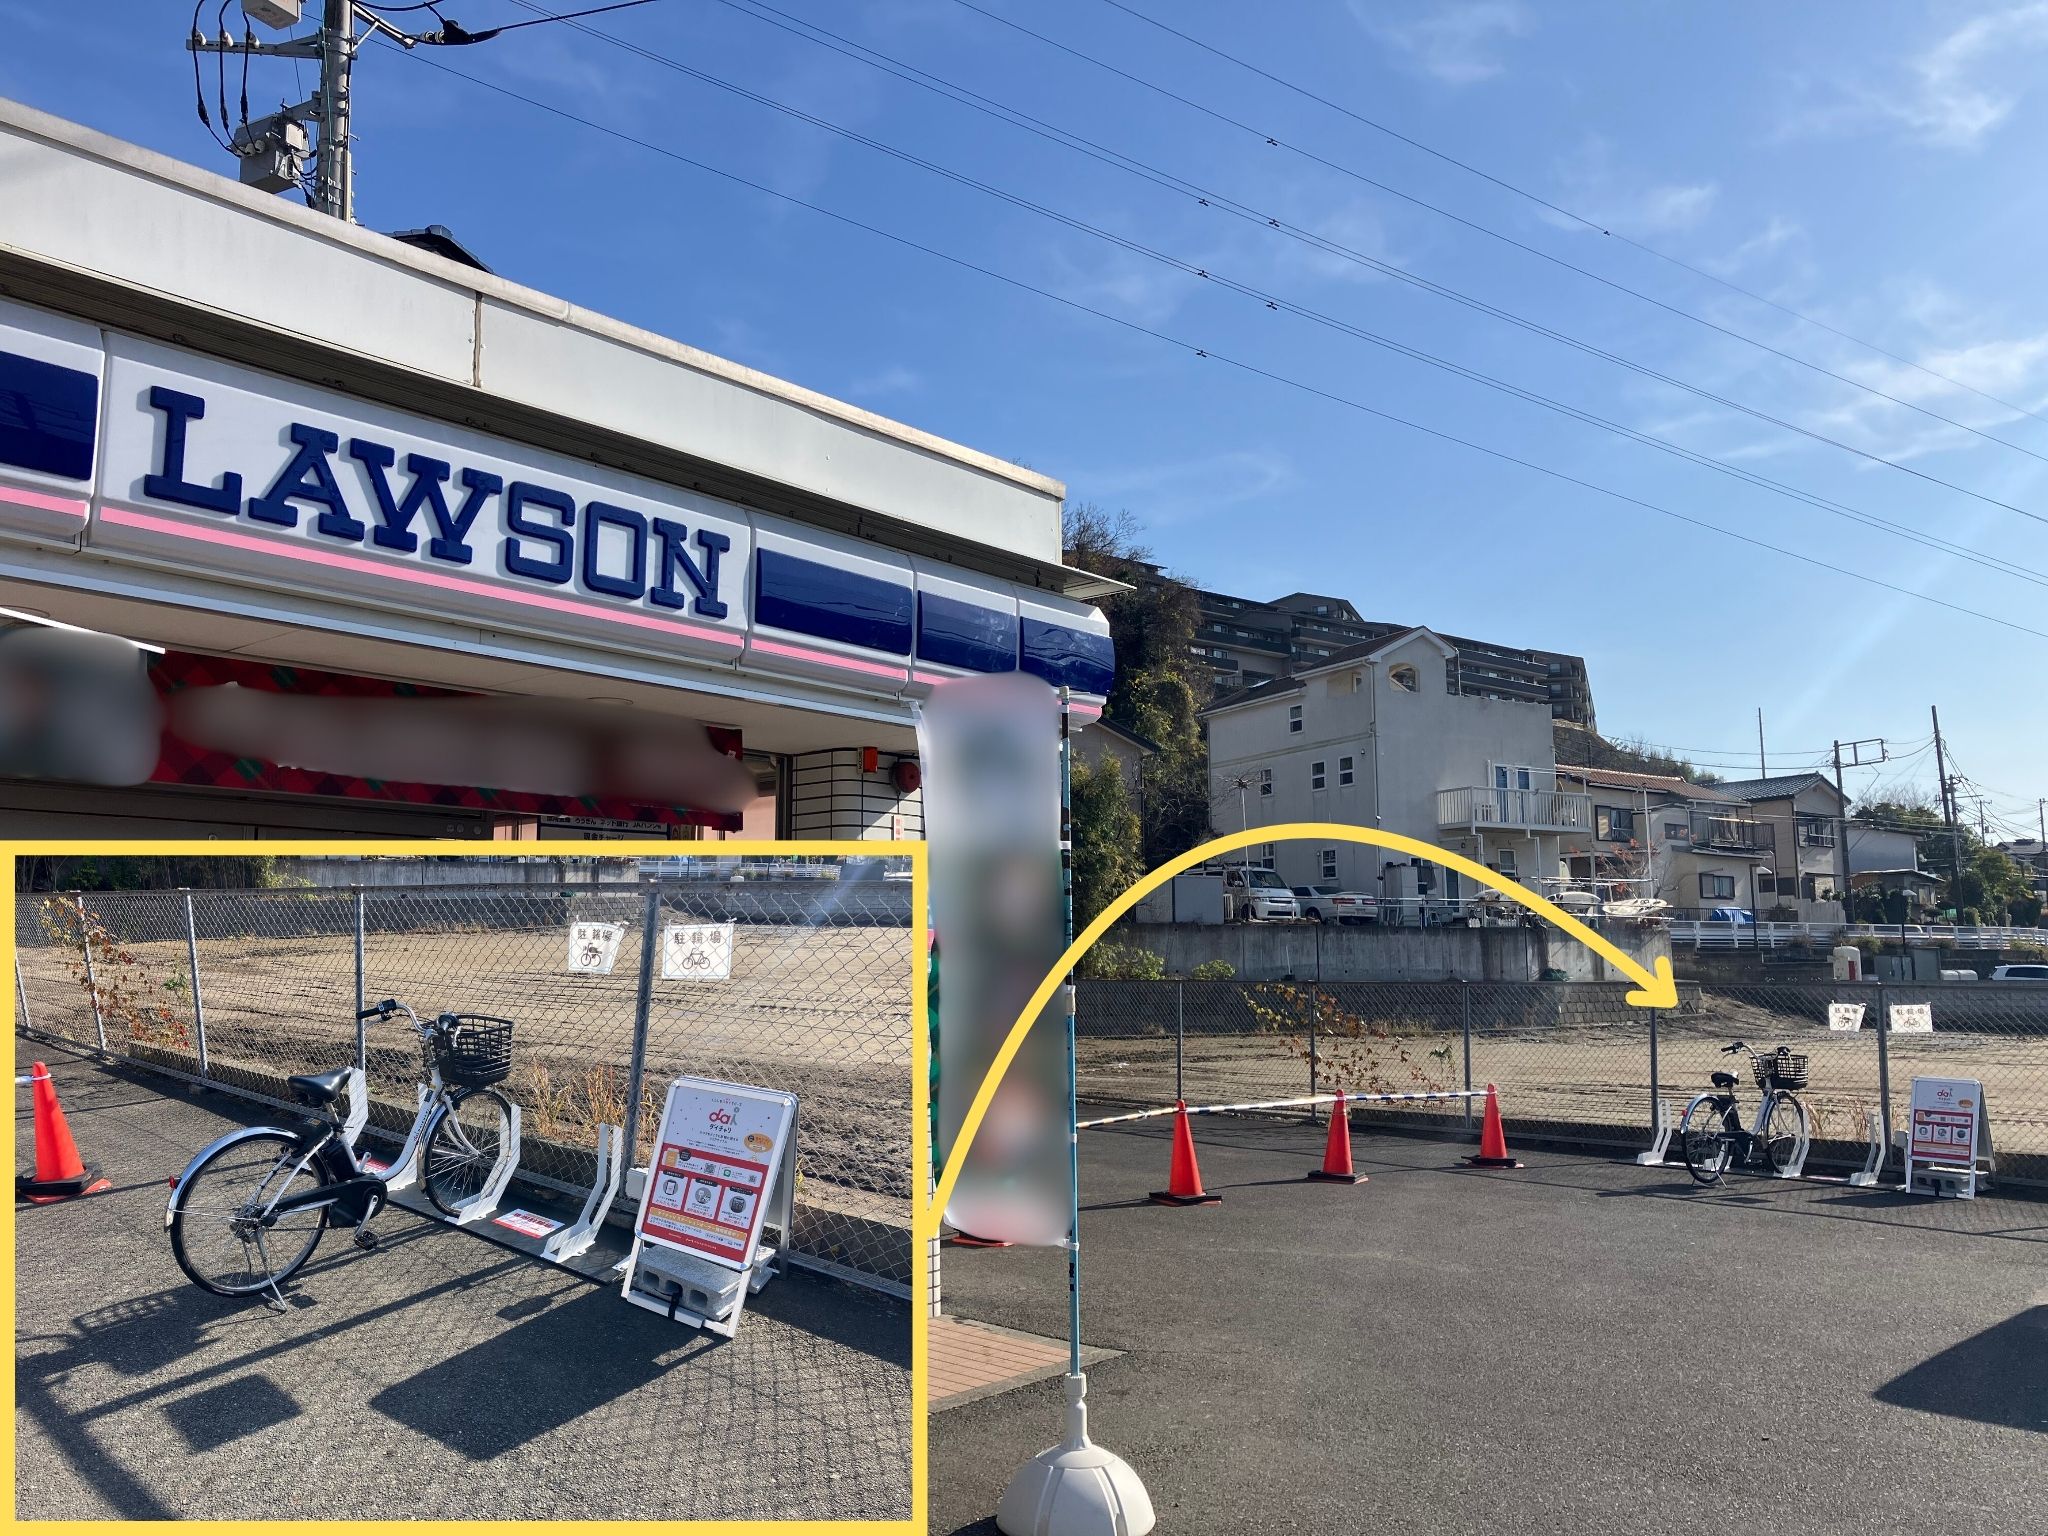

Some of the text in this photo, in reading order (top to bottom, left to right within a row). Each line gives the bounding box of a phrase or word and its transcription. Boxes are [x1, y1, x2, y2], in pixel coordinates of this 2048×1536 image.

[143, 385, 731, 619] LAWSON
[577, 928, 613, 942] 駐輪場
[673, 930, 721, 945] 駐輪場
[709, 1106, 738, 1125] dai
[709, 1123, 732, 1133] ダイチャリ
